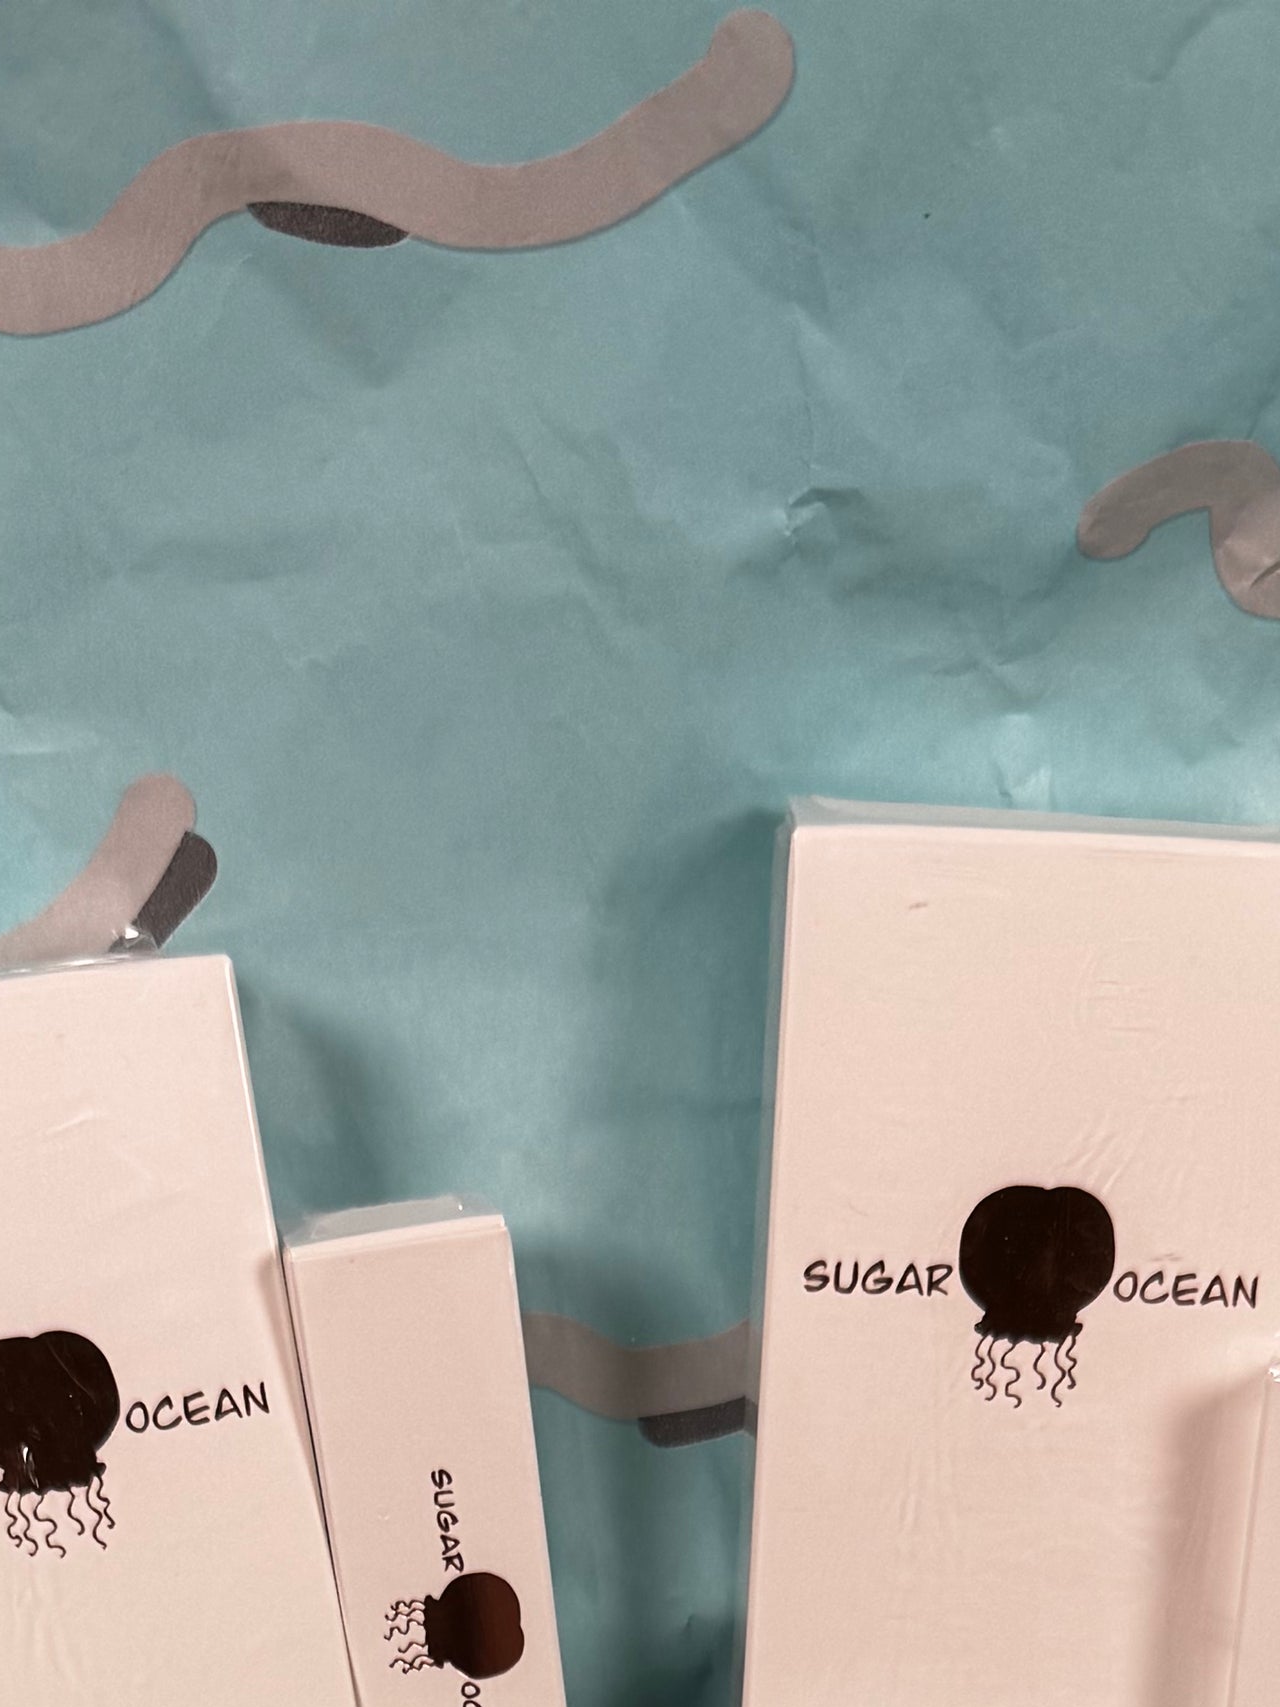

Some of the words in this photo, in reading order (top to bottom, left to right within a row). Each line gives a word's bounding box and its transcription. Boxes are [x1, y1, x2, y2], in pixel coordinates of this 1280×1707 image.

[803, 1259, 953, 1296] SUGAR
[1113, 1271, 1259, 1309] OCEAN
[125, 1381, 270, 1433] OCEAN
[430, 1468, 465, 1574] SUGAR
